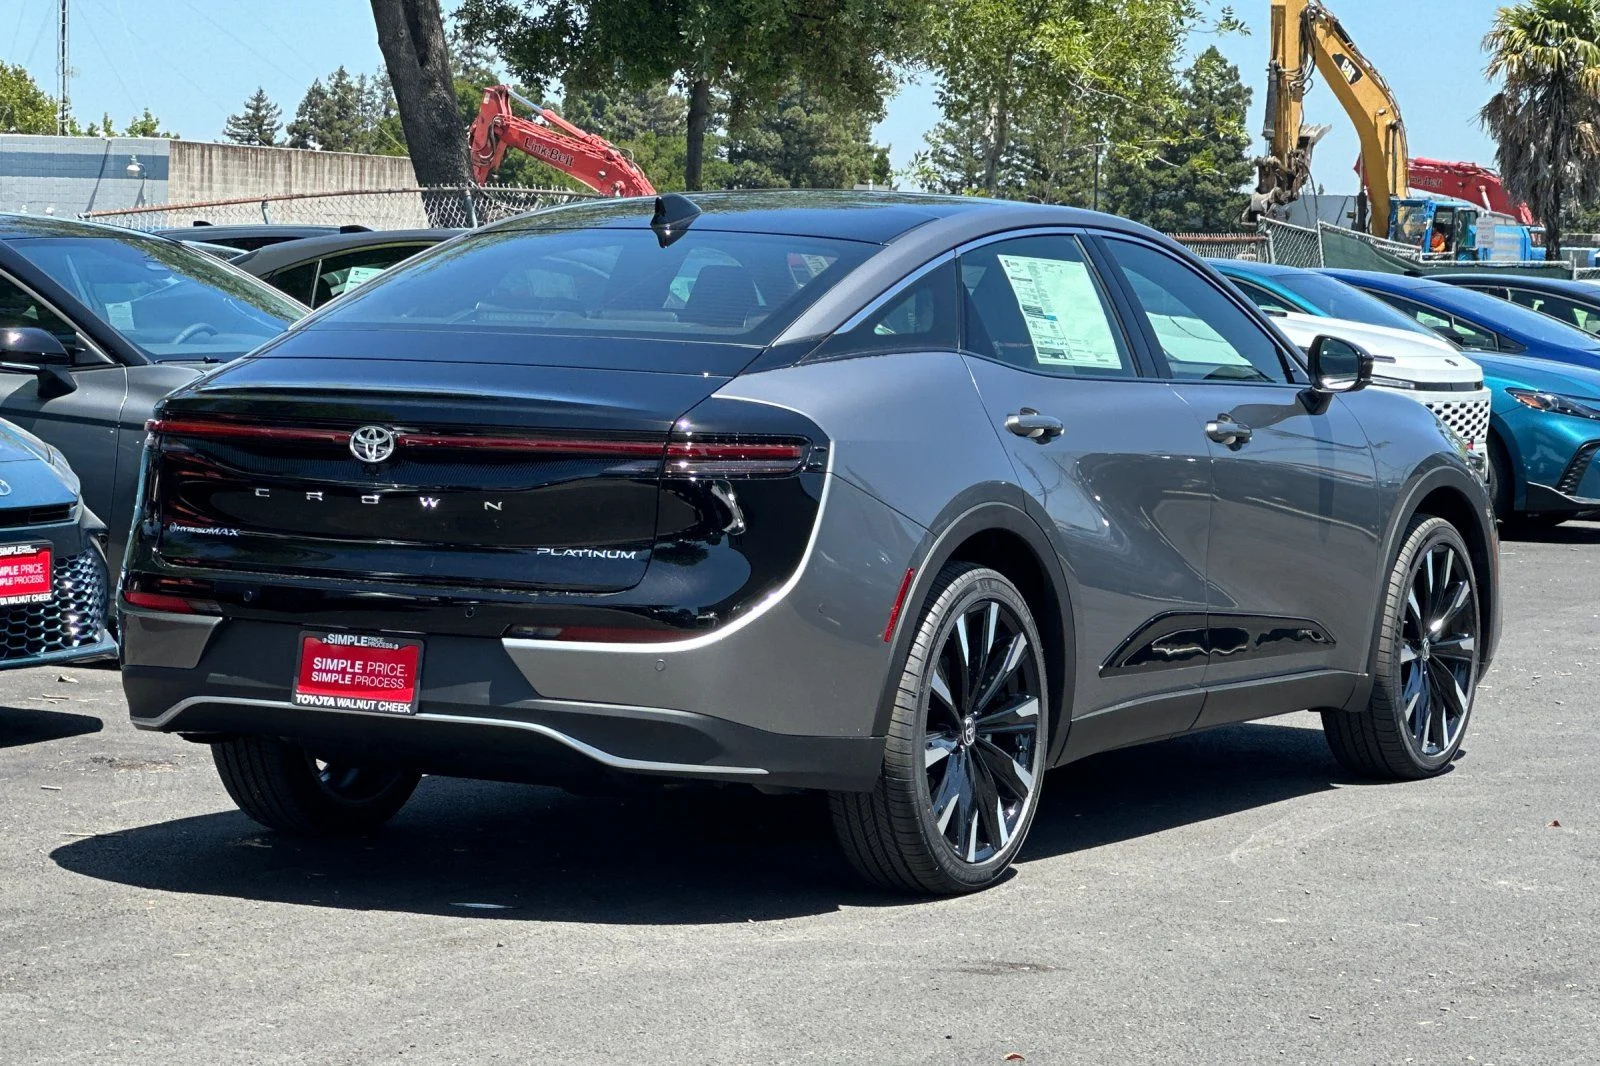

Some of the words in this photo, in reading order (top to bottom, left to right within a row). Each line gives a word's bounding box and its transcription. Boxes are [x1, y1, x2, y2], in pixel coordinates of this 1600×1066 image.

[255, 487, 503, 512] CROWN
[536, 547, 637, 560] PLATINUM
[327, 633, 368, 646] SIMPLE
[313, 657, 363, 673] SIMPLE
[366, 661, 408, 677] PRICE.
[311, 671, 352, 684] SIMPLE
[354, 675, 406, 689] PROCESS.
[295, 693, 335, 707] TOYOTA
[336, 697, 376, 710] WALNUT
